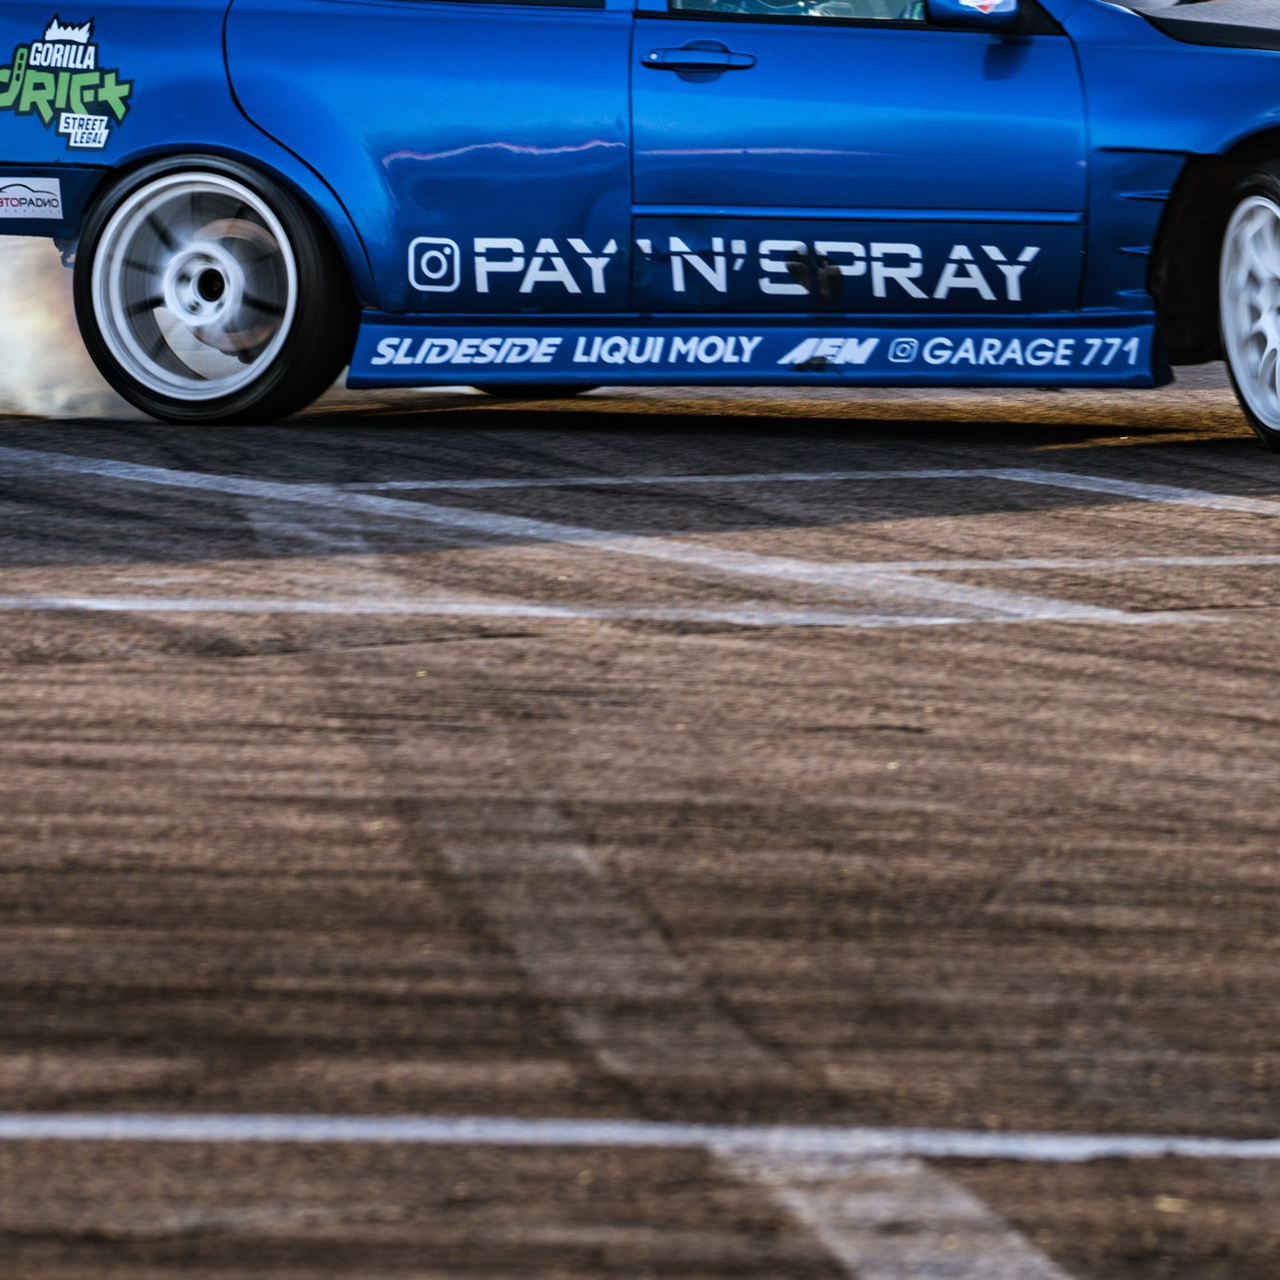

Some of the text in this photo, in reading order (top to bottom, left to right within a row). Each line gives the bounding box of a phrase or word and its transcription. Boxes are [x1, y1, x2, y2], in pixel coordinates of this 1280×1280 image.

[29, 42, 95, 70] GORILLA
[63, 116, 104, 131] STREET
[73, 131, 103, 145] LEGAL
[370, 337, 563, 365] SLIDESIDE
[572, 336, 664, 365] LIQUI
[667, 335, 764, 364] MOLY
[922, 336, 1075, 366] GARAGE
[1080, 337, 1141, 366] 771
